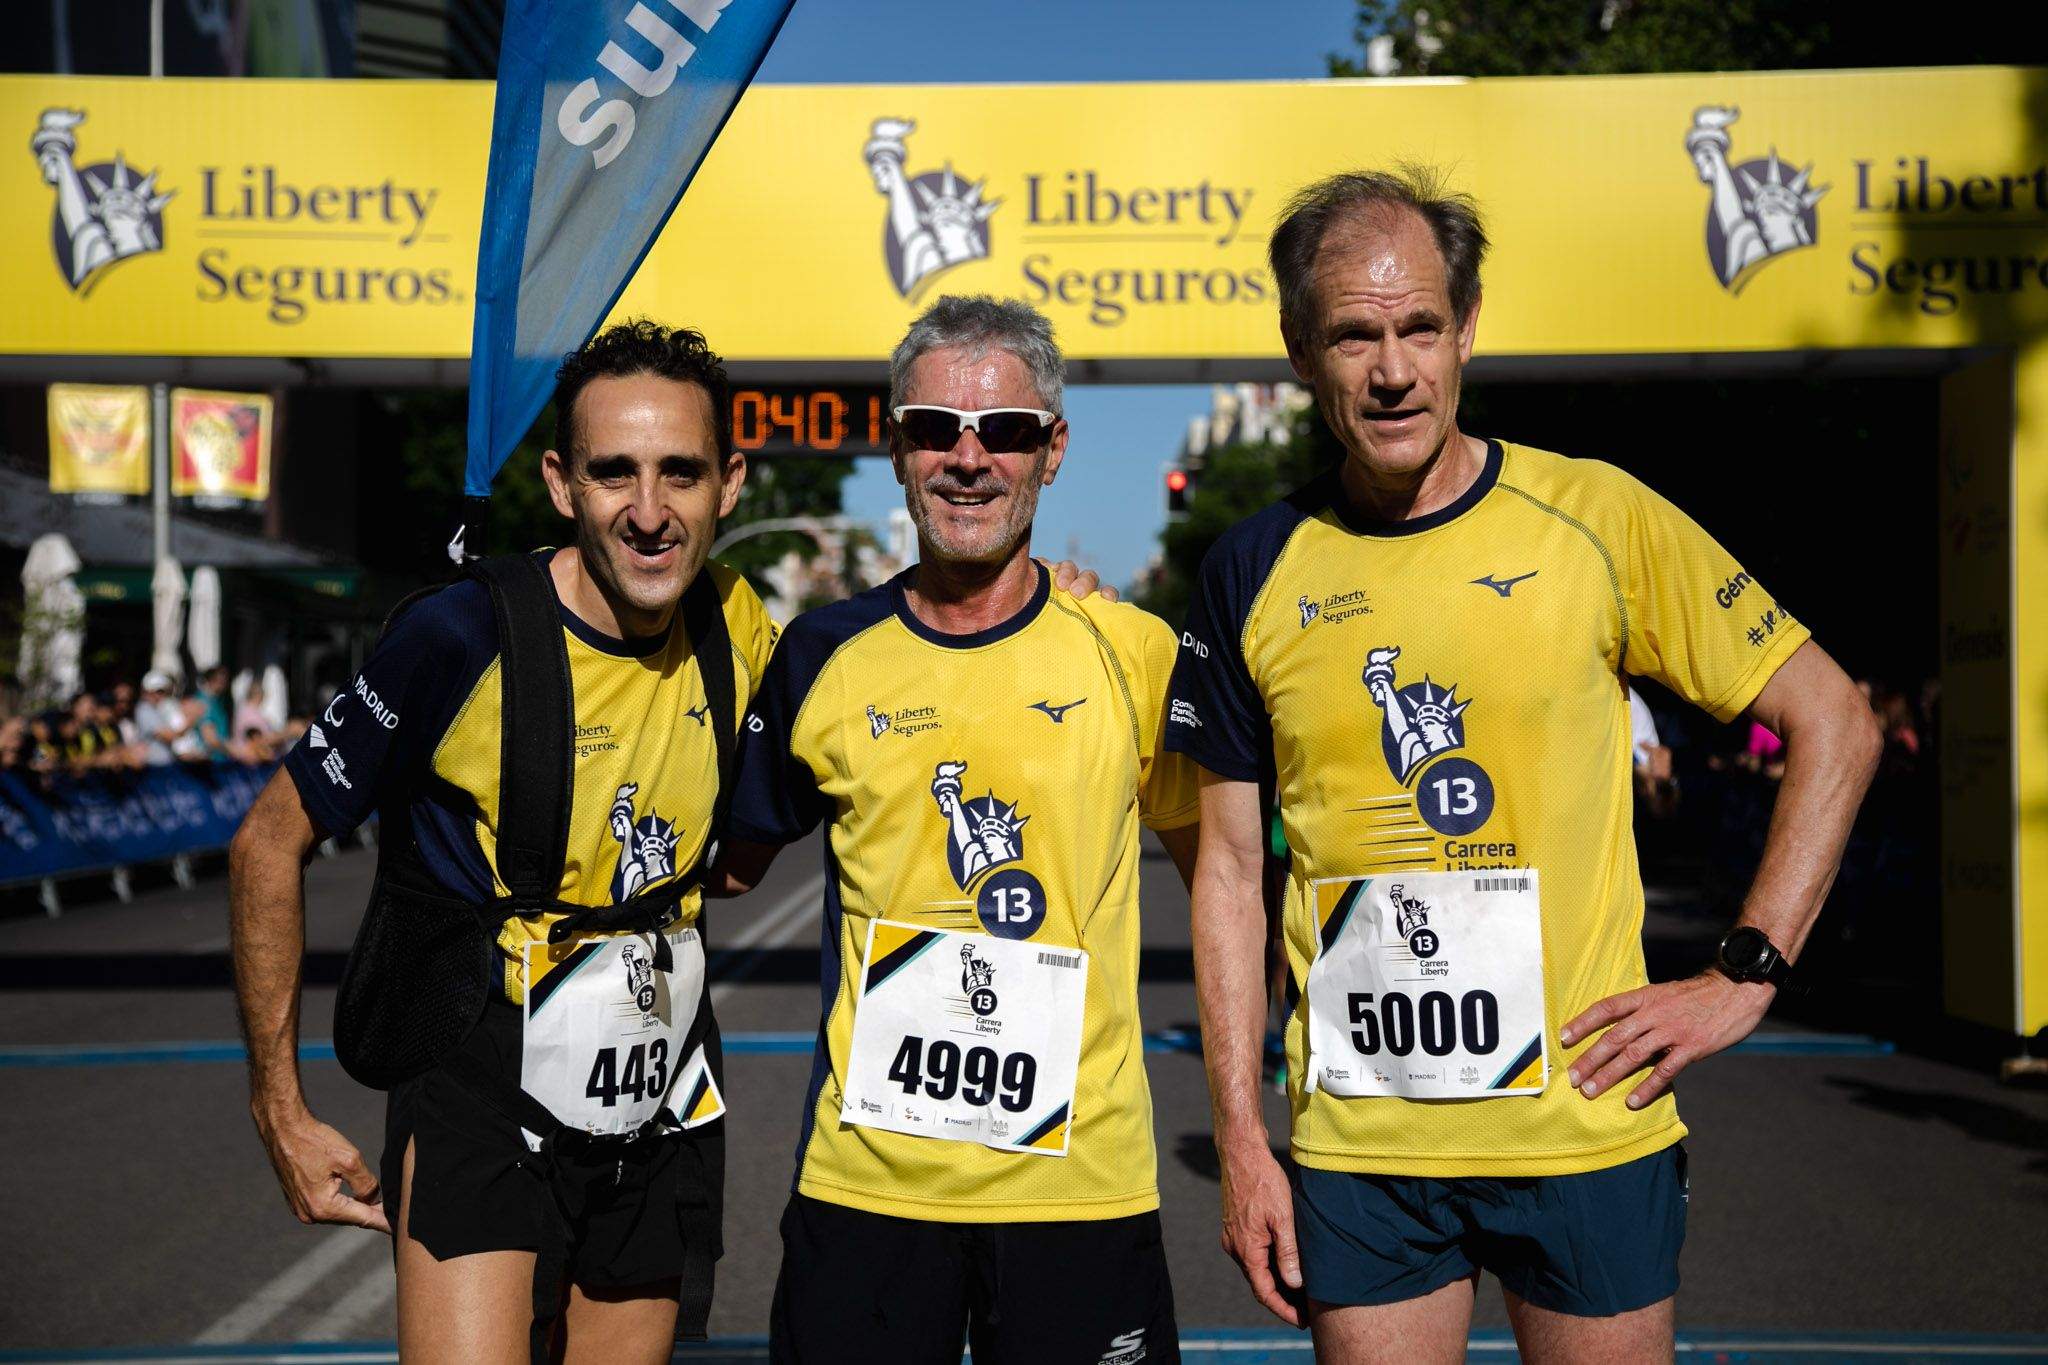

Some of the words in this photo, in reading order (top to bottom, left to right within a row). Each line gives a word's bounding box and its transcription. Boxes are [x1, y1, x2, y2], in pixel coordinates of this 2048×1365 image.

[199, 165, 440, 247] Liberty
[1023, 168, 1255, 247] Liberty
[1325, 589, 1367, 608] Liberty
[1715, 571, 1753, 609] Gén
[1182, 631, 1209, 659] DRID
[354, 674, 399, 729] MADRID
[747, 713, 764, 732] ID
[895, 706, 937, 721] Liberty
[573, 724, 612, 738] iberty
[573, 741, 619, 757] eguros.
[1432, 777, 1478, 816] 13
[1444, 841, 1516, 859] Carrera
[992, 887, 1033, 923] 13
[1415, 936, 1433, 952] 13
[1419, 960, 1448, 968] Carrera
[1420, 968, 1449, 977] Liberty
[641, 990, 653, 1006] 13
[976, 994, 992, 1010] 13
[642, 1019, 659, 1028] Liberty
[975, 1024, 1001, 1035] Liberty
[976, 1016, 1002, 1027] Carrera
[1347, 989, 1500, 1057] 5000
[586, 1038, 668, 1107] 443
[888, 1035, 1037, 1113] 4999
